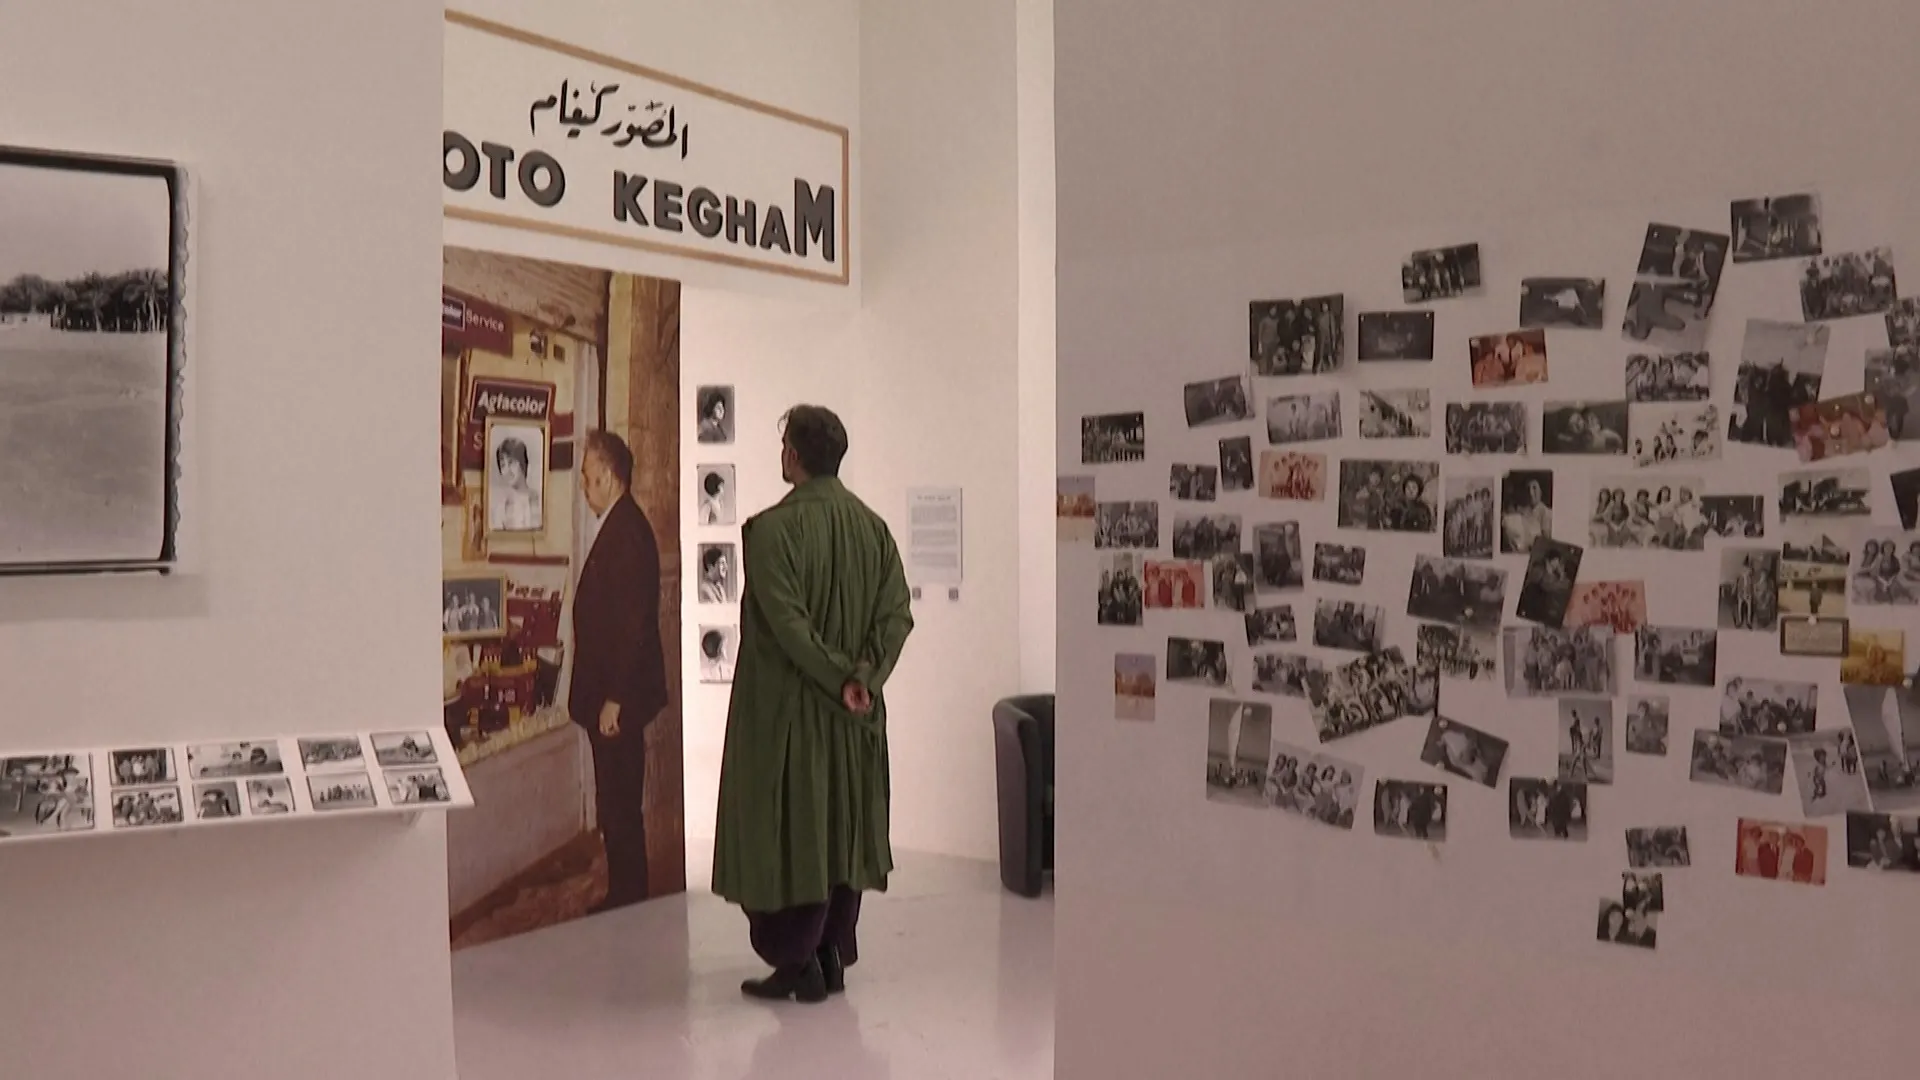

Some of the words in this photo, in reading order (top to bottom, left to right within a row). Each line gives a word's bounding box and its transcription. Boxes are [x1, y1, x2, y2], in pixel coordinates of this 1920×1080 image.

[613, 169, 835, 262] KEGHAM
[466, 308, 504, 332] Service
[478, 390, 546, 415] Agfacolor
